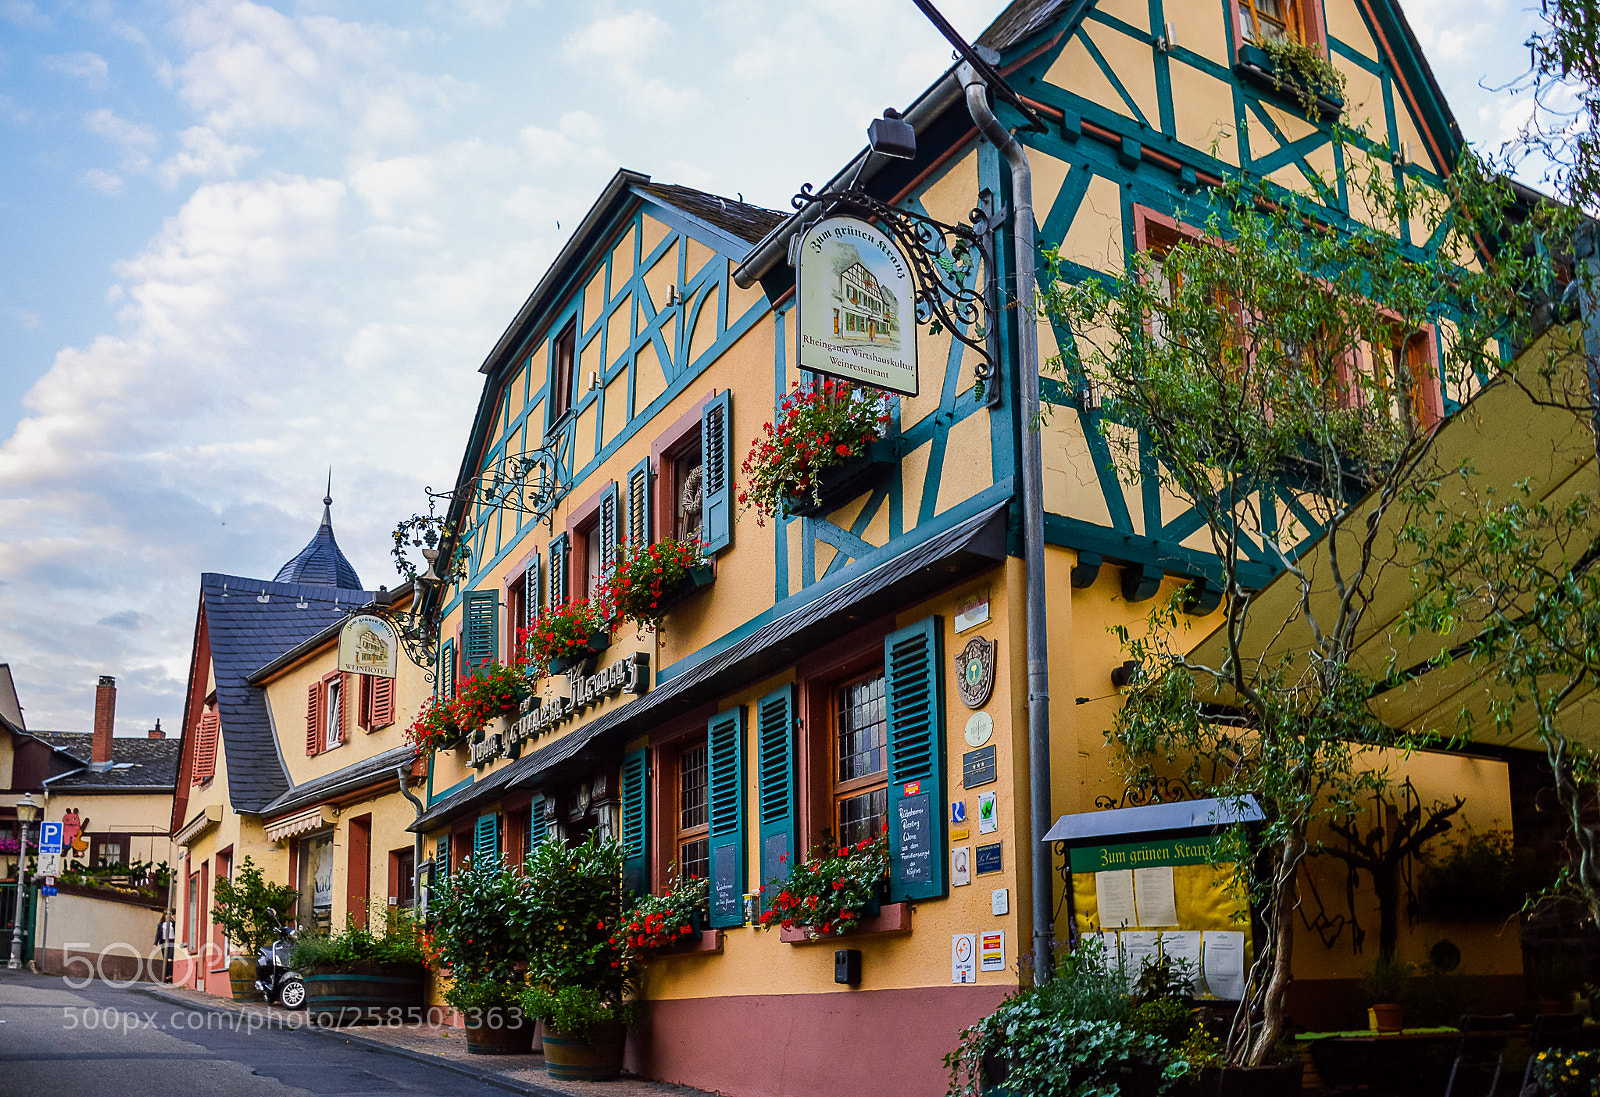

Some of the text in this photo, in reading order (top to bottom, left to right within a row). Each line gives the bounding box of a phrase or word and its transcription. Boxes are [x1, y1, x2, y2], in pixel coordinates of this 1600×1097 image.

[810, 225, 906, 280] Zum grünen Kranz
[803, 334, 915, 372] Rheingauer Wirtshauskultur
[829, 355, 889, 379] Weinrestaurant
[345, 663, 388, 675] WEINHOTEL
[44, 824, 58, 844] P
[1100, 842, 1211, 867] Zum grünen Kranz
